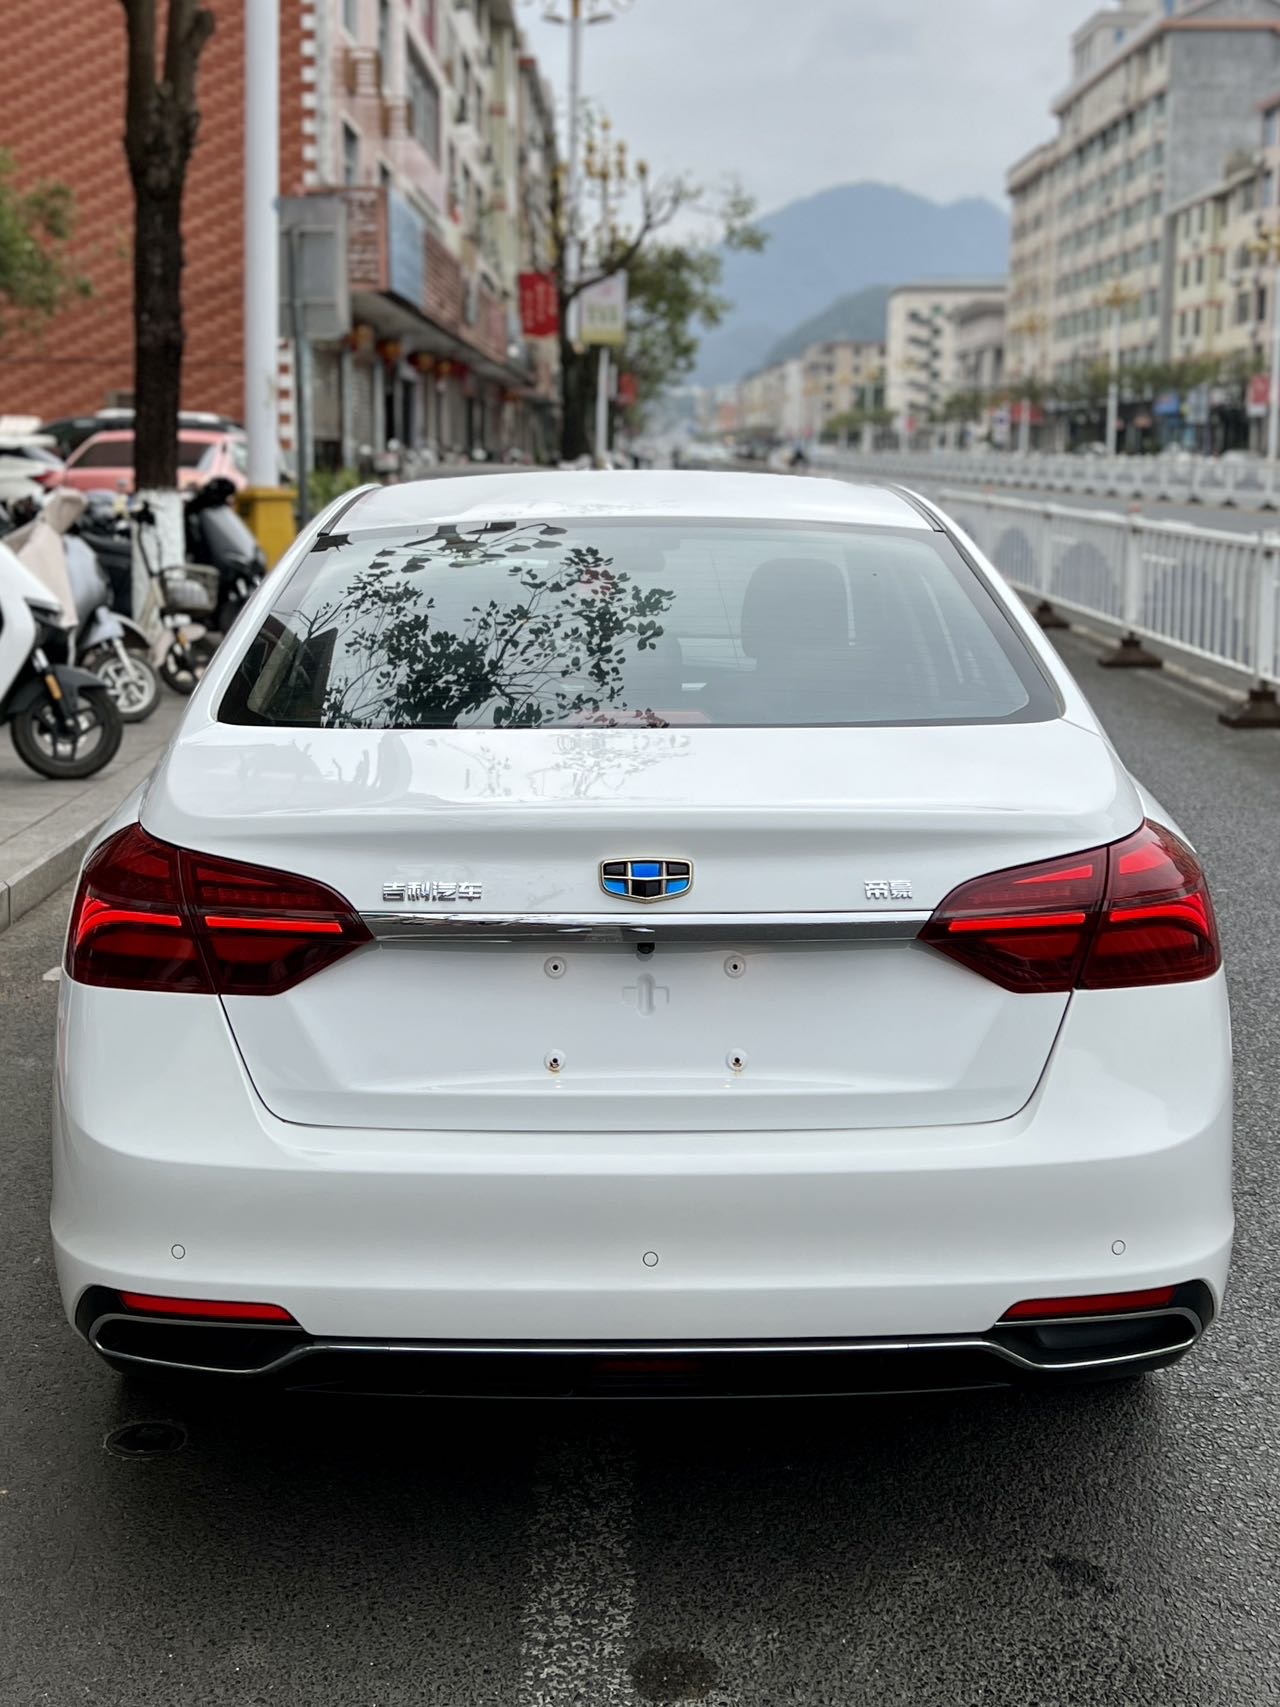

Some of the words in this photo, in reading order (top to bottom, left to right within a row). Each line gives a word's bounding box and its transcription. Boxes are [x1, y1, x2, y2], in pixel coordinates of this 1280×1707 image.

[383, 881, 482, 901] 吉利汽车
[864, 879, 912, 900] 帝豪
